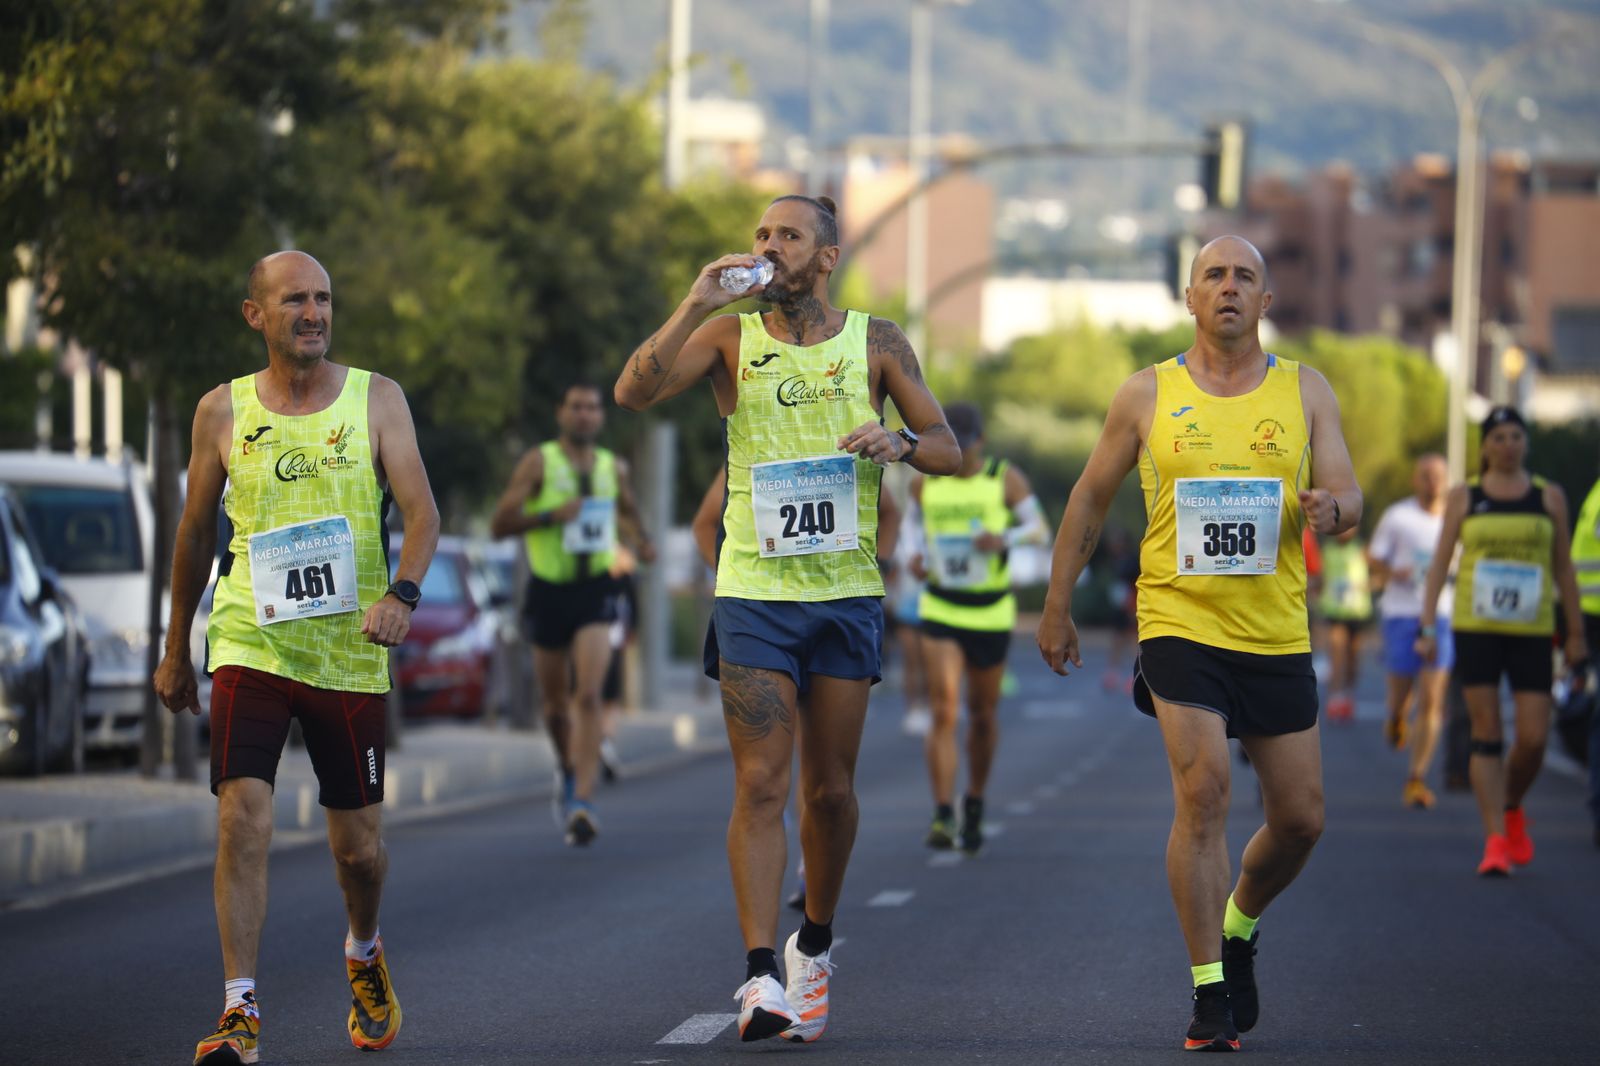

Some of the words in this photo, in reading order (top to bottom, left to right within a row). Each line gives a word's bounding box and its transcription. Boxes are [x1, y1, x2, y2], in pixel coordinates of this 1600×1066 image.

[757, 479, 794, 492] MEDIA
[797, 470, 853, 488] MARATÓN
[1180, 496, 1217, 507] MEDIA
[1221, 493, 1279, 507] MARATÓN
[779, 500, 835, 539] 240
[254, 545, 290, 562] MEDIA
[294, 531, 351, 552] MARATÓN
[1203, 522, 1256, 557] 358
[285, 562, 336, 602] 461
[366, 746, 378, 785] joma
